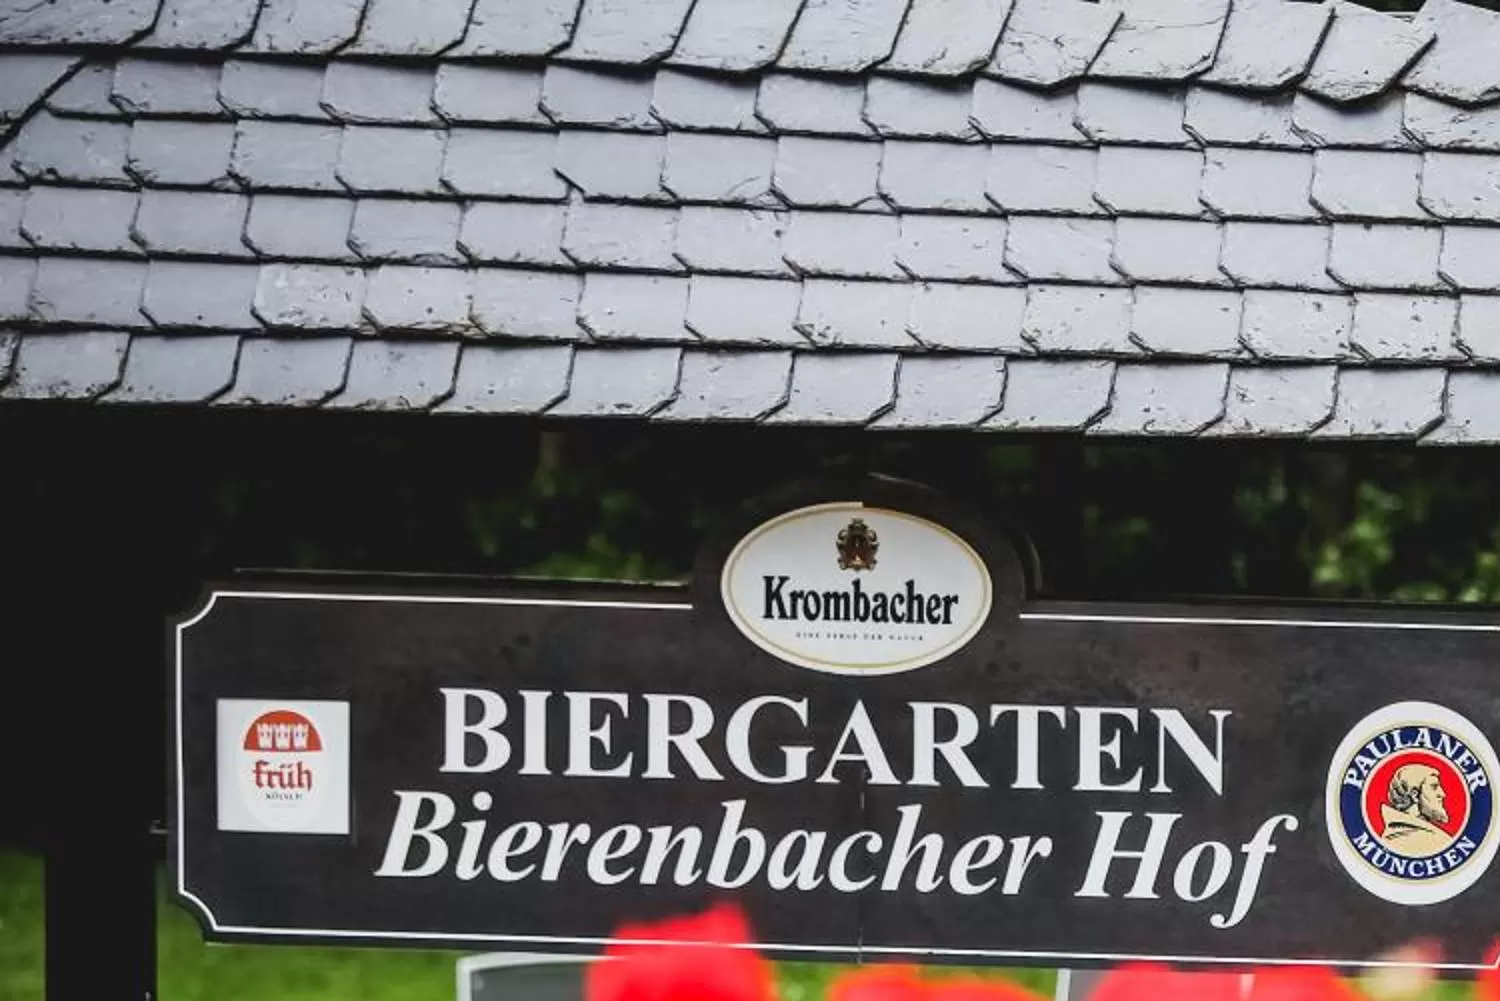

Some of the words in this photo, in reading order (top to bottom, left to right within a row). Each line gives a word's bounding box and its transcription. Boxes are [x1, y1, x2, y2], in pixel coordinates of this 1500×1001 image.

[763, 575, 959, 625] Krombacher
[440, 687, 1233, 796] BIERGARTEN
[1344, 727, 1487, 792] PAULANER
[252, 759, 313, 792] früh
[375, 790, 1053, 894] Bierenbacher
[1074, 811, 1299, 929] Hof
